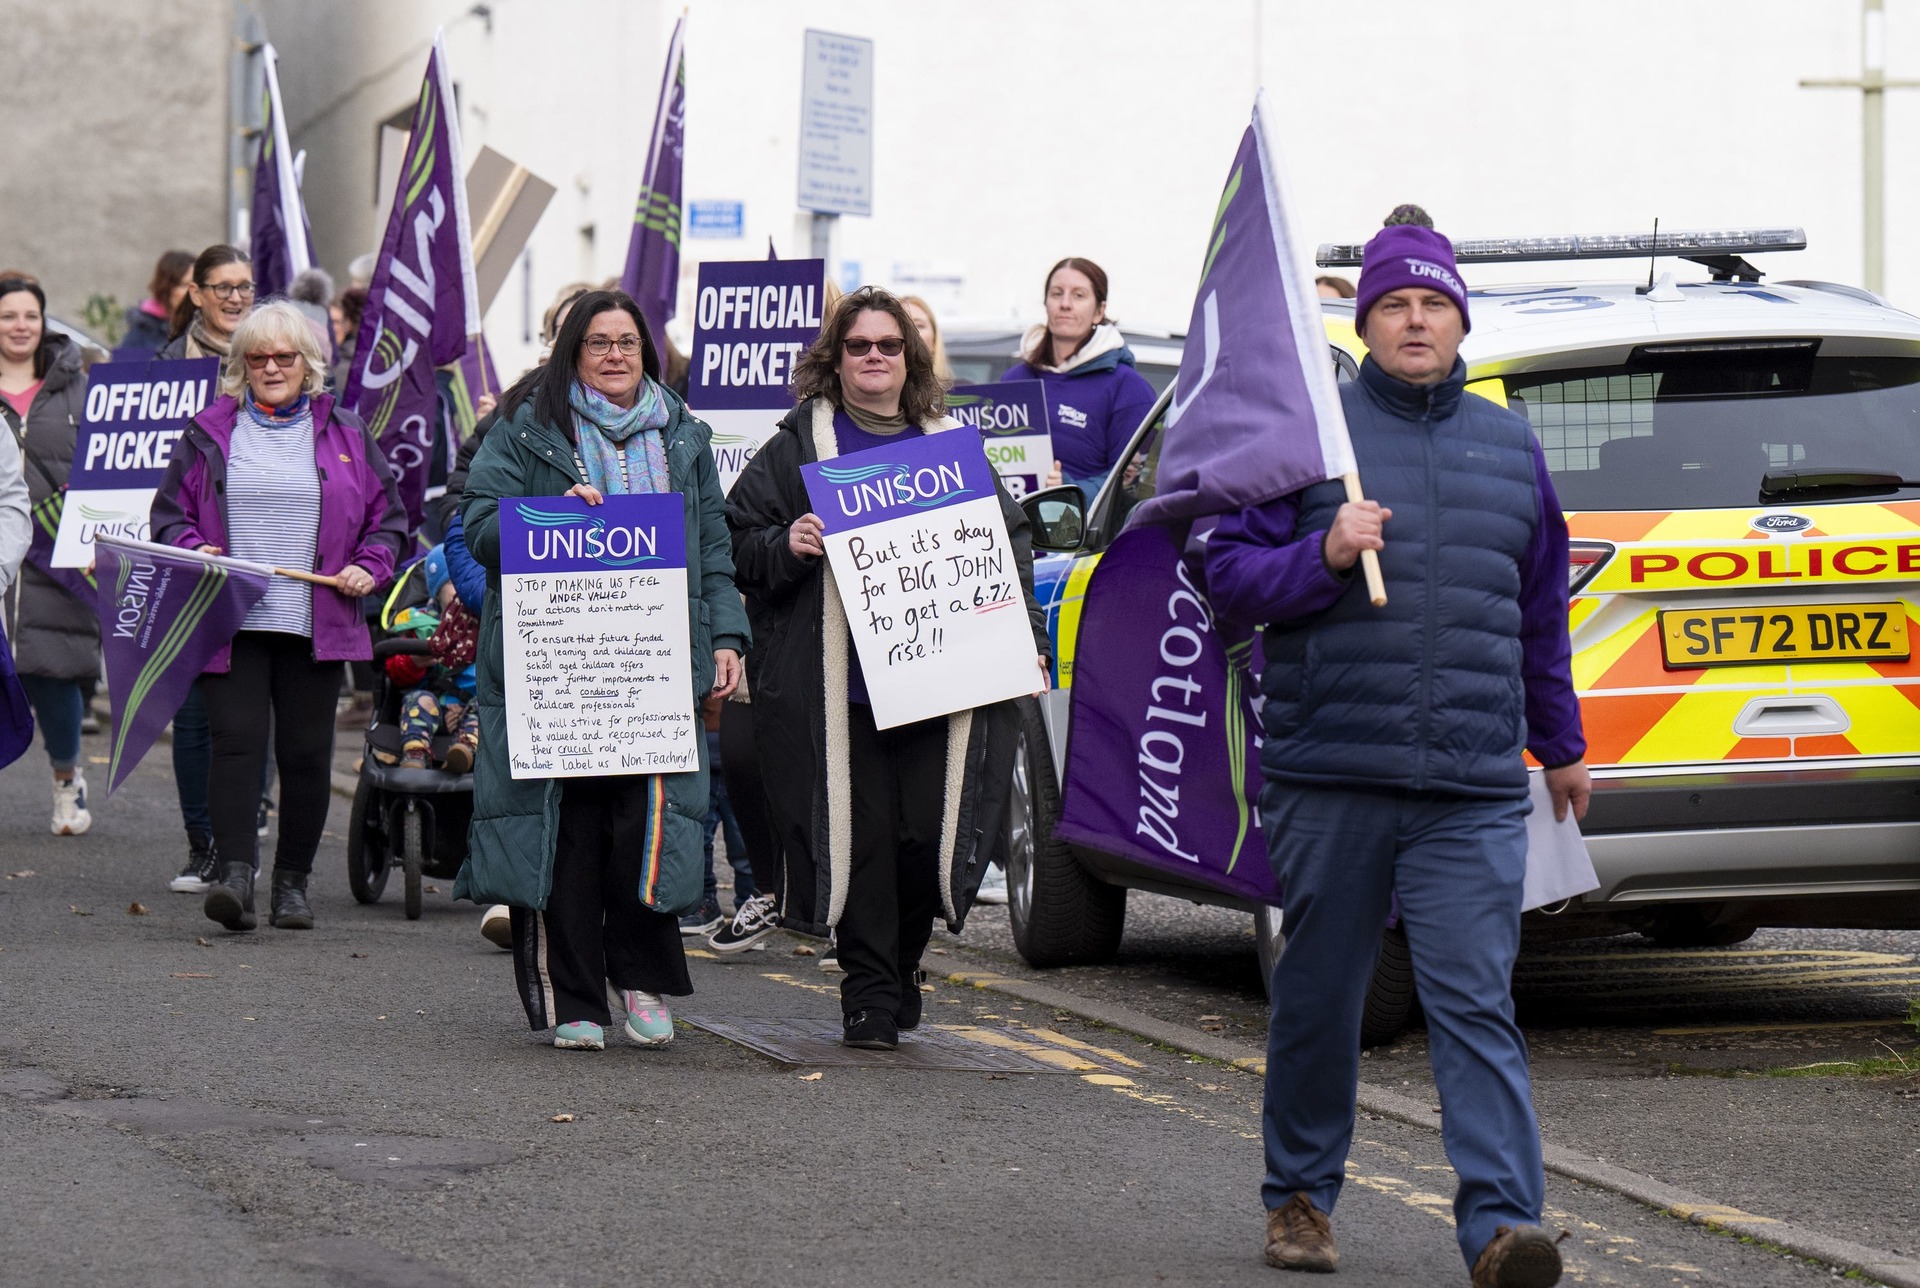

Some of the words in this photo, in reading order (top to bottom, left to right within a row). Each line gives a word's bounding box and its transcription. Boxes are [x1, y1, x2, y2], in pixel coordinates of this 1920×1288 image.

[1410, 264, 1465, 298] UNISON
[698, 284, 821, 331] OFFICIAL
[701, 342, 803, 387] PICKET
[951, 403, 1029, 430] NISON
[84, 430, 184, 471] PICKE
[837, 461, 965, 516] UNISON
[1767, 516, 1798, 527] Ford
[528, 526, 656, 561] UNISON
[848, 536, 901, 571] But
[911, 529, 941, 554] it's
[954, 519, 994, 551] okay
[515, 578, 547, 592] STOP
[556, 578, 603, 592] MAKING
[610, 577, 623, 589] US
[630, 576, 660, 588] FEEL
[860, 575, 887, 611] for
[898, 560, 936, 593] BIG
[945, 548, 1002, 587] JOHN
[550, 592, 584, 604] UNDER
[516, 601, 538, 616] Your
[545, 605, 580, 615] actions
[588, 604, 613, 613] don't
[616, 603, 644, 612] match
[646, 603, 664, 616] your
[869, 610, 893, 635] to
[905, 599, 939, 643] get
[949, 599, 968, 613] a
[542, 636, 575, 644] ensure
[576, 633, 595, 644] that
[599, 633, 630, 645] future
[633, 633, 664, 646] funded
[1683, 614, 1796, 656] SF72
[1807, 612, 1891, 651] DRZ
[526, 649, 547, 662] early
[554, 647, 586, 660] learning
[593, 647, 610, 656] and
[614, 647, 651, 656] childcare
[657, 648, 671, 656] and
[887, 627, 944, 666] rise!!
[559, 662, 577, 674] aged
[582, 661, 615, 670] childcare
[620, 661, 644, 672] offers
[565, 673, 596, 687] further
[603, 672, 655, 685] improvements
[659, 673, 670, 682] to
[529, 689, 543, 701] pay
[555, 686, 571, 695] and
[580, 687, 619, 696] conditions
[627, 687, 642, 698] for
[549, 718, 567, 728] will
[571, 717, 602, 727] strive
[608, 715, 621, 728] for
[627, 712, 681, 726] professionals
[682, 713, 691, 721] to
[531, 732, 542, 742] be
[546, 731, 578, 741] valued
[582, 730, 603, 740] and
[608, 728, 666, 745] recognised
[672, 727, 689, 740] for
[531, 745, 553, 755] their
[558, 743, 593, 753] crucial
[598, 760, 609, 768] us
